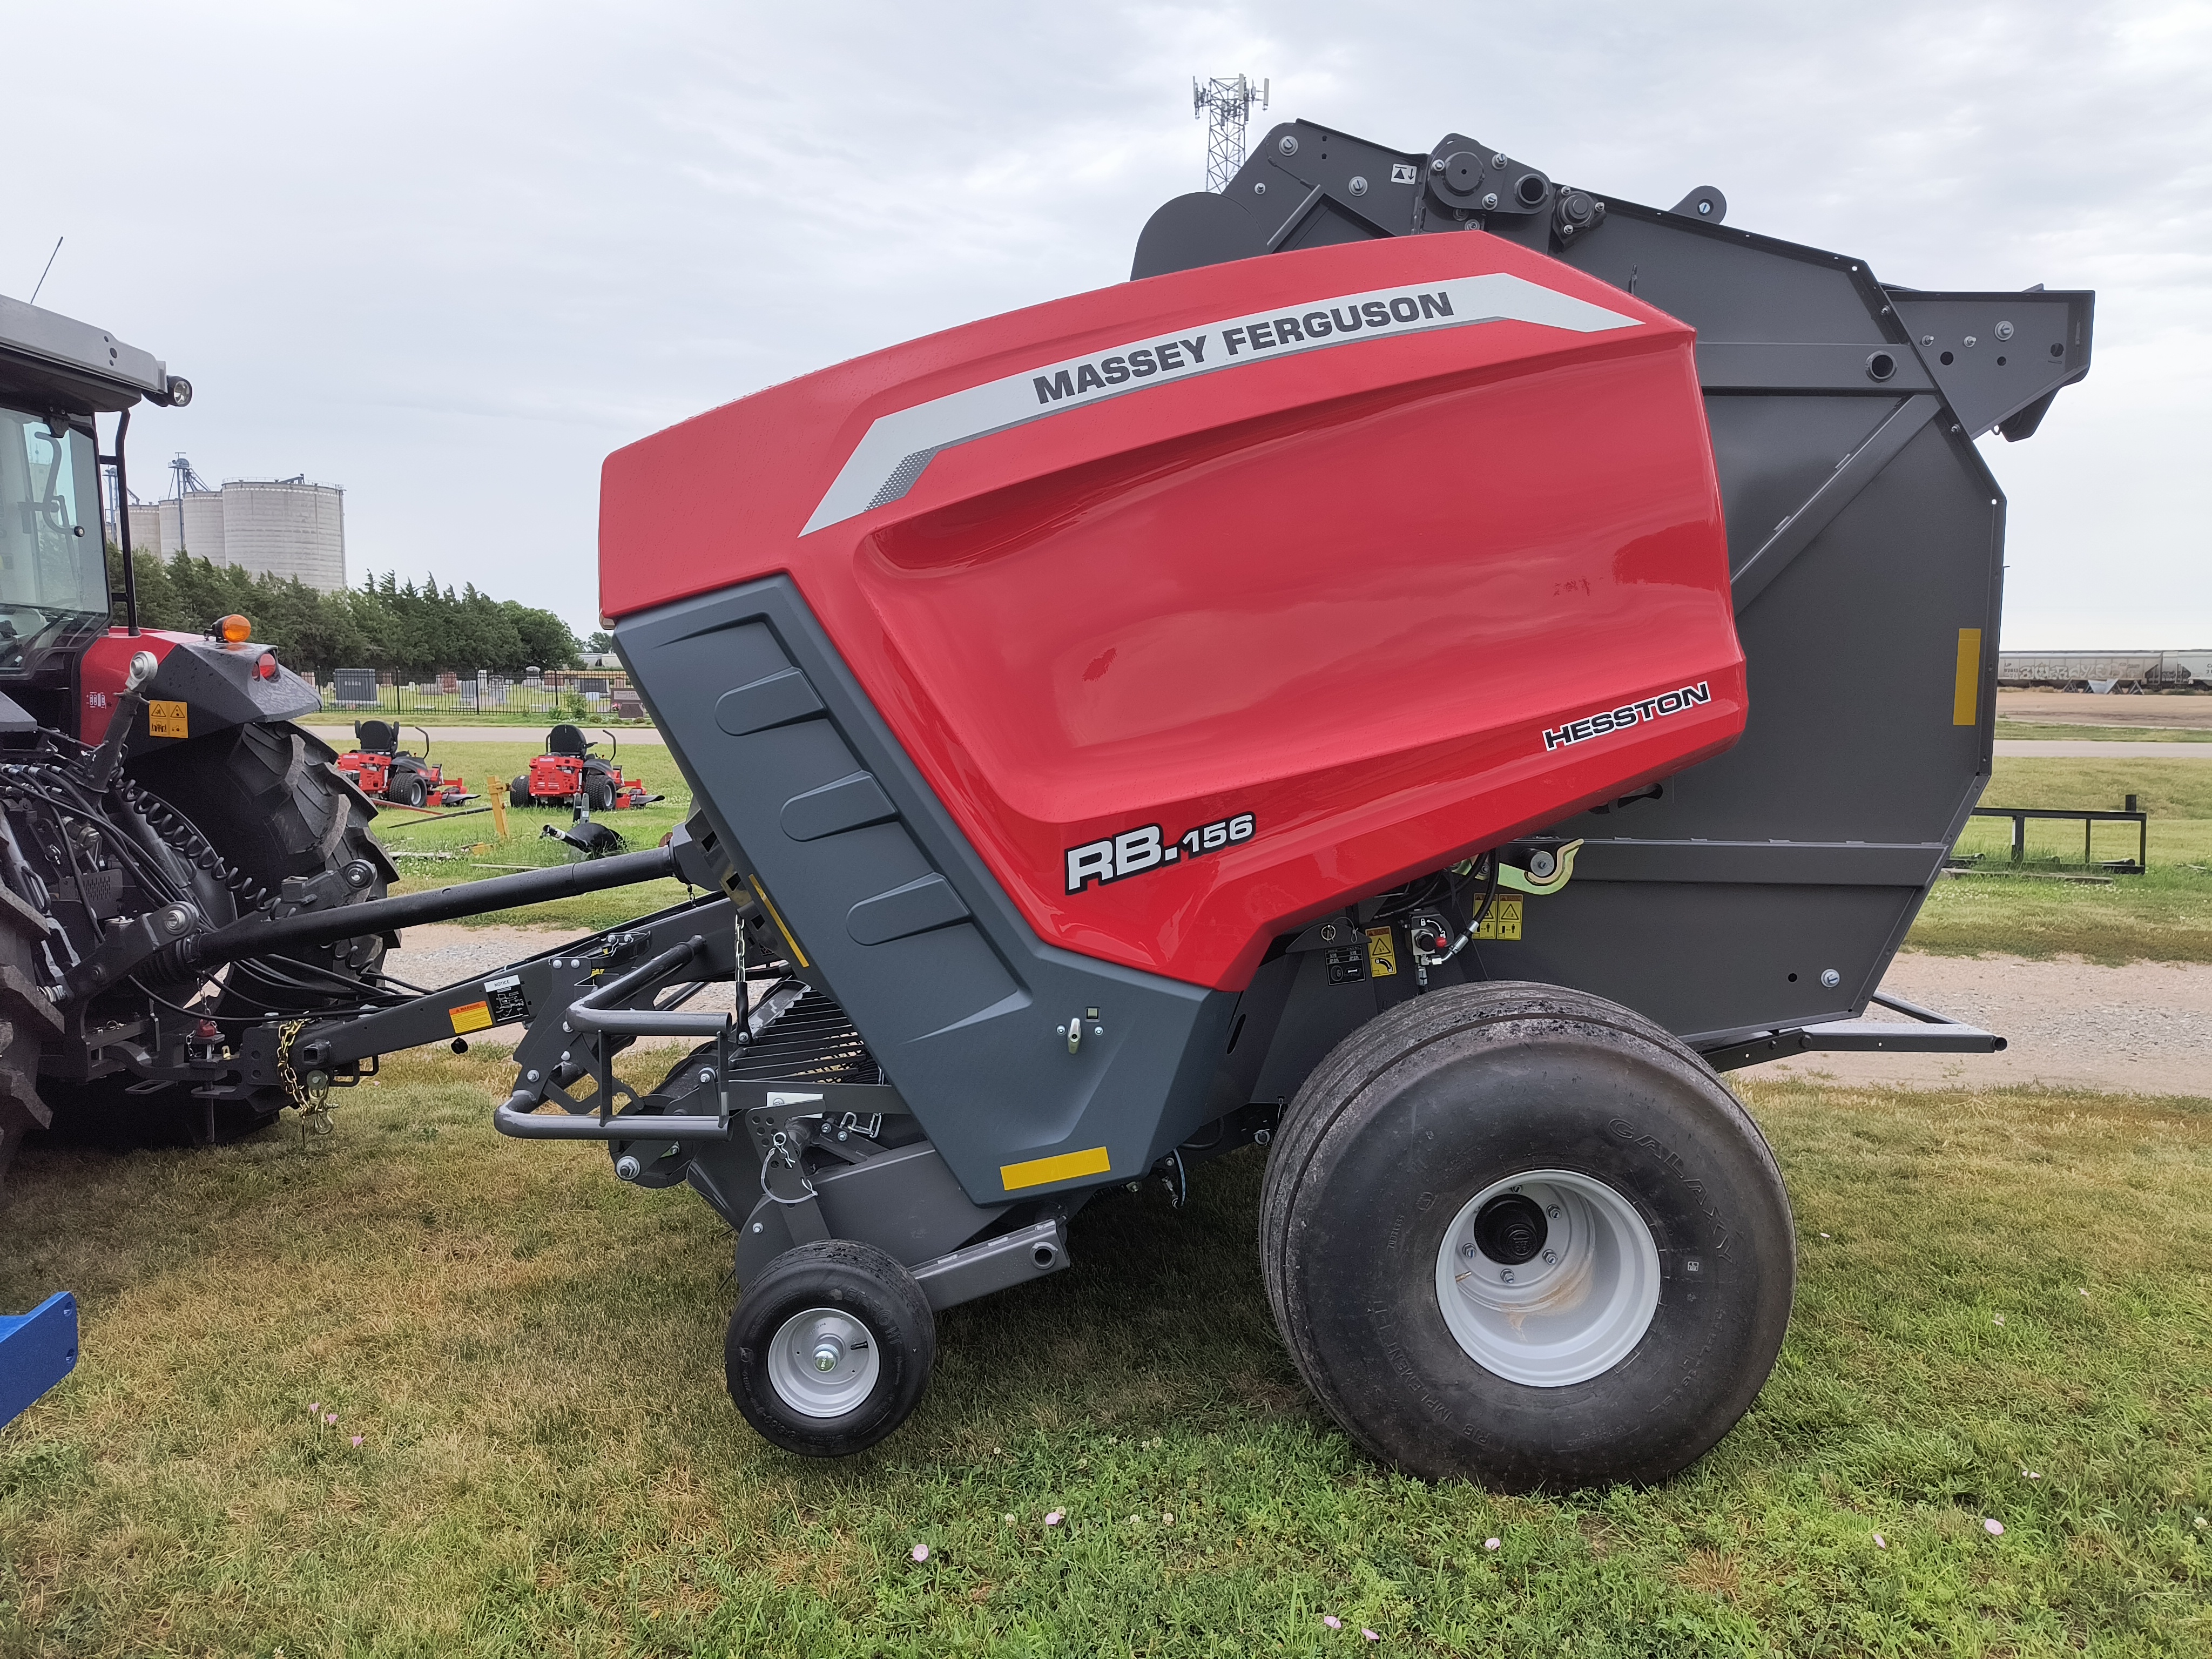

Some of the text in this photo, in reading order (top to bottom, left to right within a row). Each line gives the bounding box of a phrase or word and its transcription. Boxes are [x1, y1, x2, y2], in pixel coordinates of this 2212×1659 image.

[1032, 291, 1454, 404] MASSEY FERGUSON
[1543, 682, 1710, 750] HESSTON
[460, 1003, 480, 1011] WARNING
[494, 979, 510, 987] NOTICE
[1608, 1118, 1733, 1263] GALAXY
[1383, 1341, 1453, 1421] IMPLEMENT
[1462, 1423, 1492, 1444] RIB
